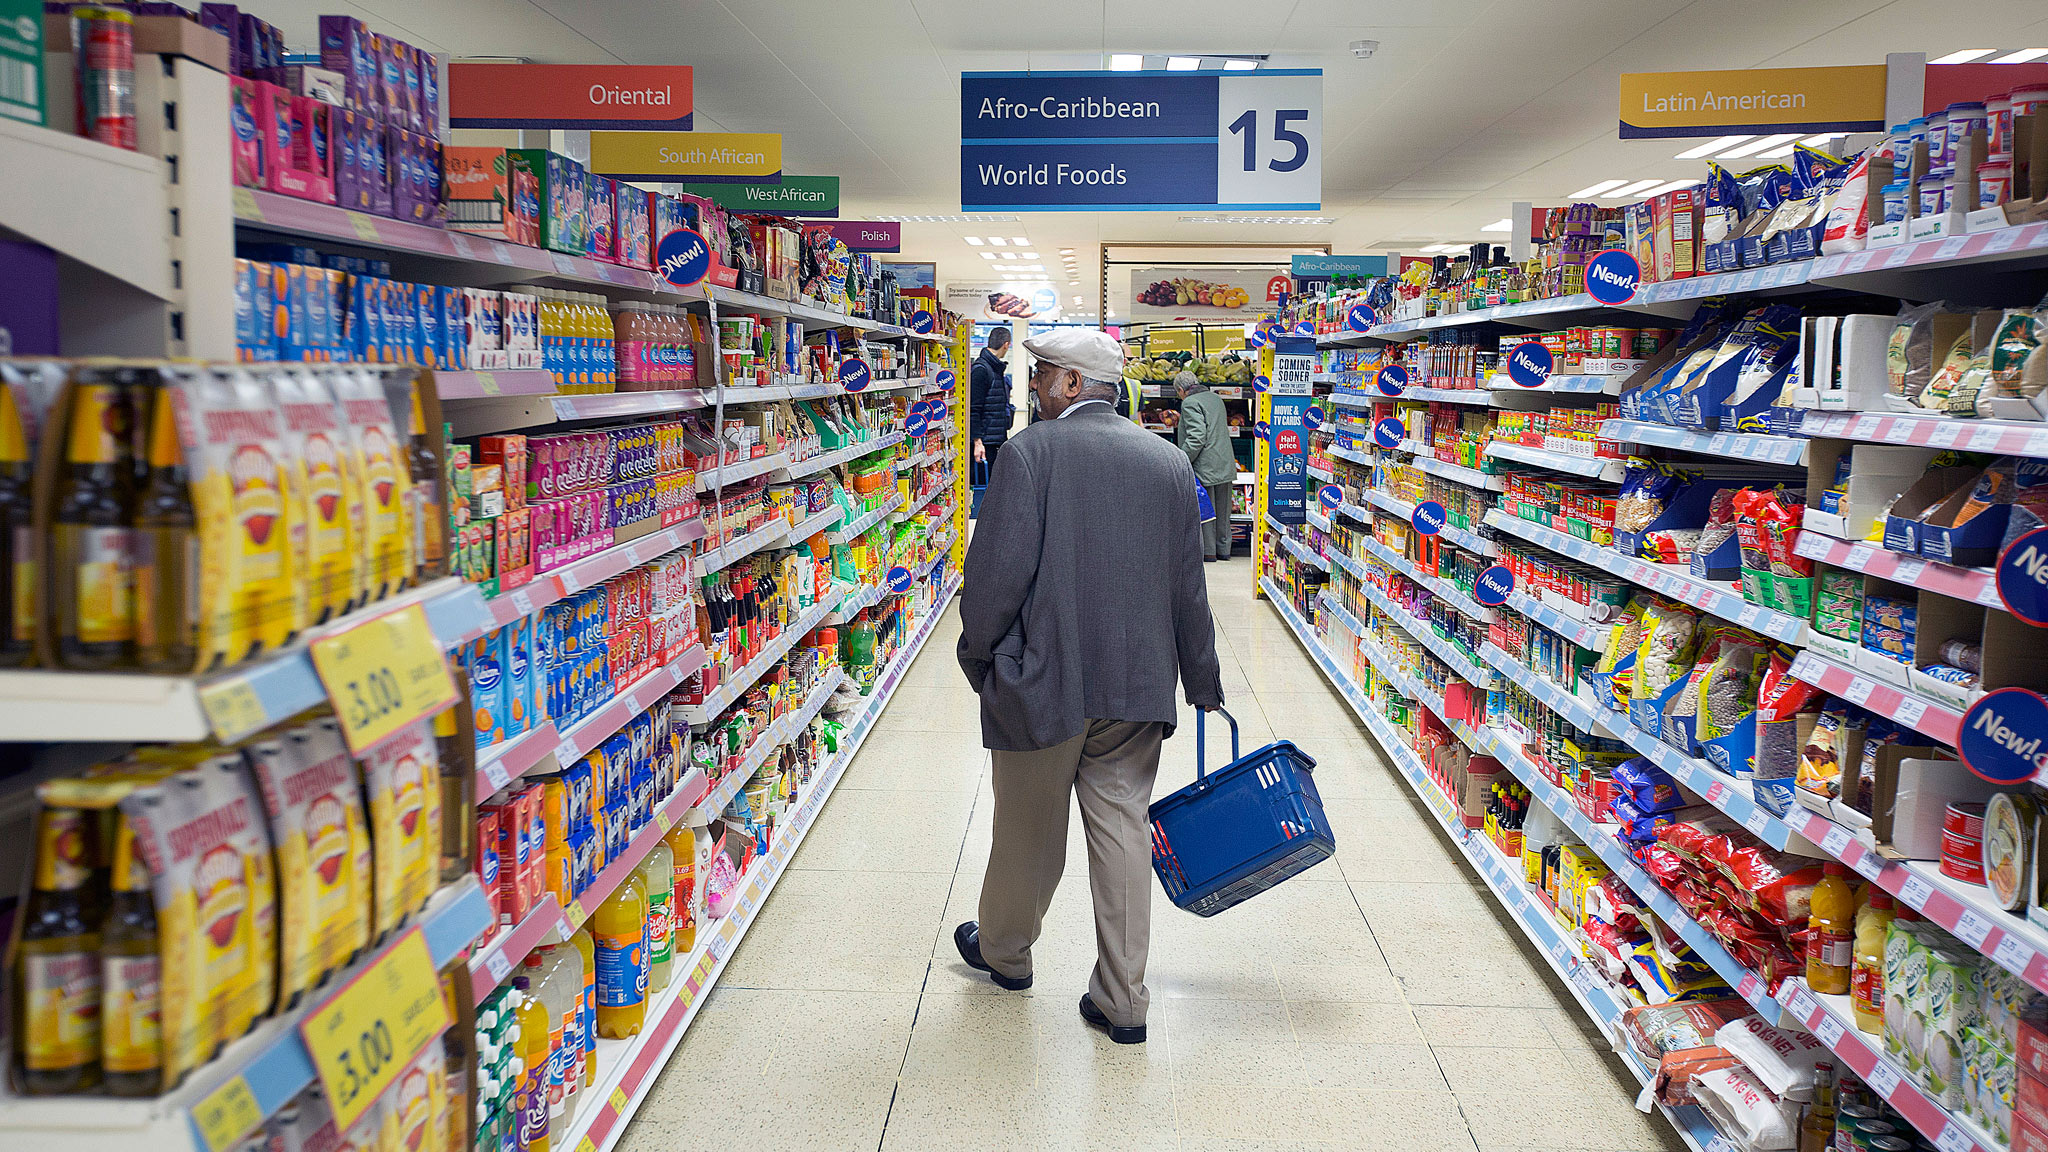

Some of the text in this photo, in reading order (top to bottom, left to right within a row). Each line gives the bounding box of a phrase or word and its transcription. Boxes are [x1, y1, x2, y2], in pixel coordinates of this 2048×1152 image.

[589, 84, 671, 106] Oriental
[1643, 90, 1806, 114] Latin American
[978, 96, 1160, 119] Afro-Caribbean
[1227, 109, 1310, 173] 15
[659, 147, 764, 165] South African
[978, 163, 1127, 186] World Foods
[746, 187, 825, 201] West African
[861, 230, 890, 241] Polish
[670, 240, 704, 274] New!
[1299, 262, 1361, 272] Afro-Caribbean
[1592, 264, 1634, 290] New!
[914, 314, 932, 329] New!
[1152, 337, 1174, 346] Oranges
[1225, 336, 1243, 344] Apples
[1279, 358, 1311, 371] COMING
[1514, 351, 1547, 377] New!
[843, 365, 867, 385] New!
[939, 374, 954, 386] New!
[1278, 370, 1310, 382] SOONER
[1381, 370, 1403, 391] New!
[1274, 404, 1299, 416] MOVIE &
[1305, 409, 1321, 425] New!
[909, 419, 926, 432] New!
[1273, 415, 1302, 426] TV CARDS
[1280, 435, 1296, 443] Half
[1378, 422, 1400, 443] New!
[1279, 443, 1297, 451] price
[1273, 498, 1302, 506] blinkbox
[1321, 488, 1338, 505] New!
[1416, 507, 1441, 528] New!
[893, 571, 909, 588] New!
[1481, 574, 1508, 598] New!
[1972, 708, 2042, 761] New!
[1744, 1017, 1760, 1032] 10
[1759, 1026, 1774, 1042] KG
[1724, 1072, 1735, 1086] 10
[1734, 1078, 1747, 1095] KG
